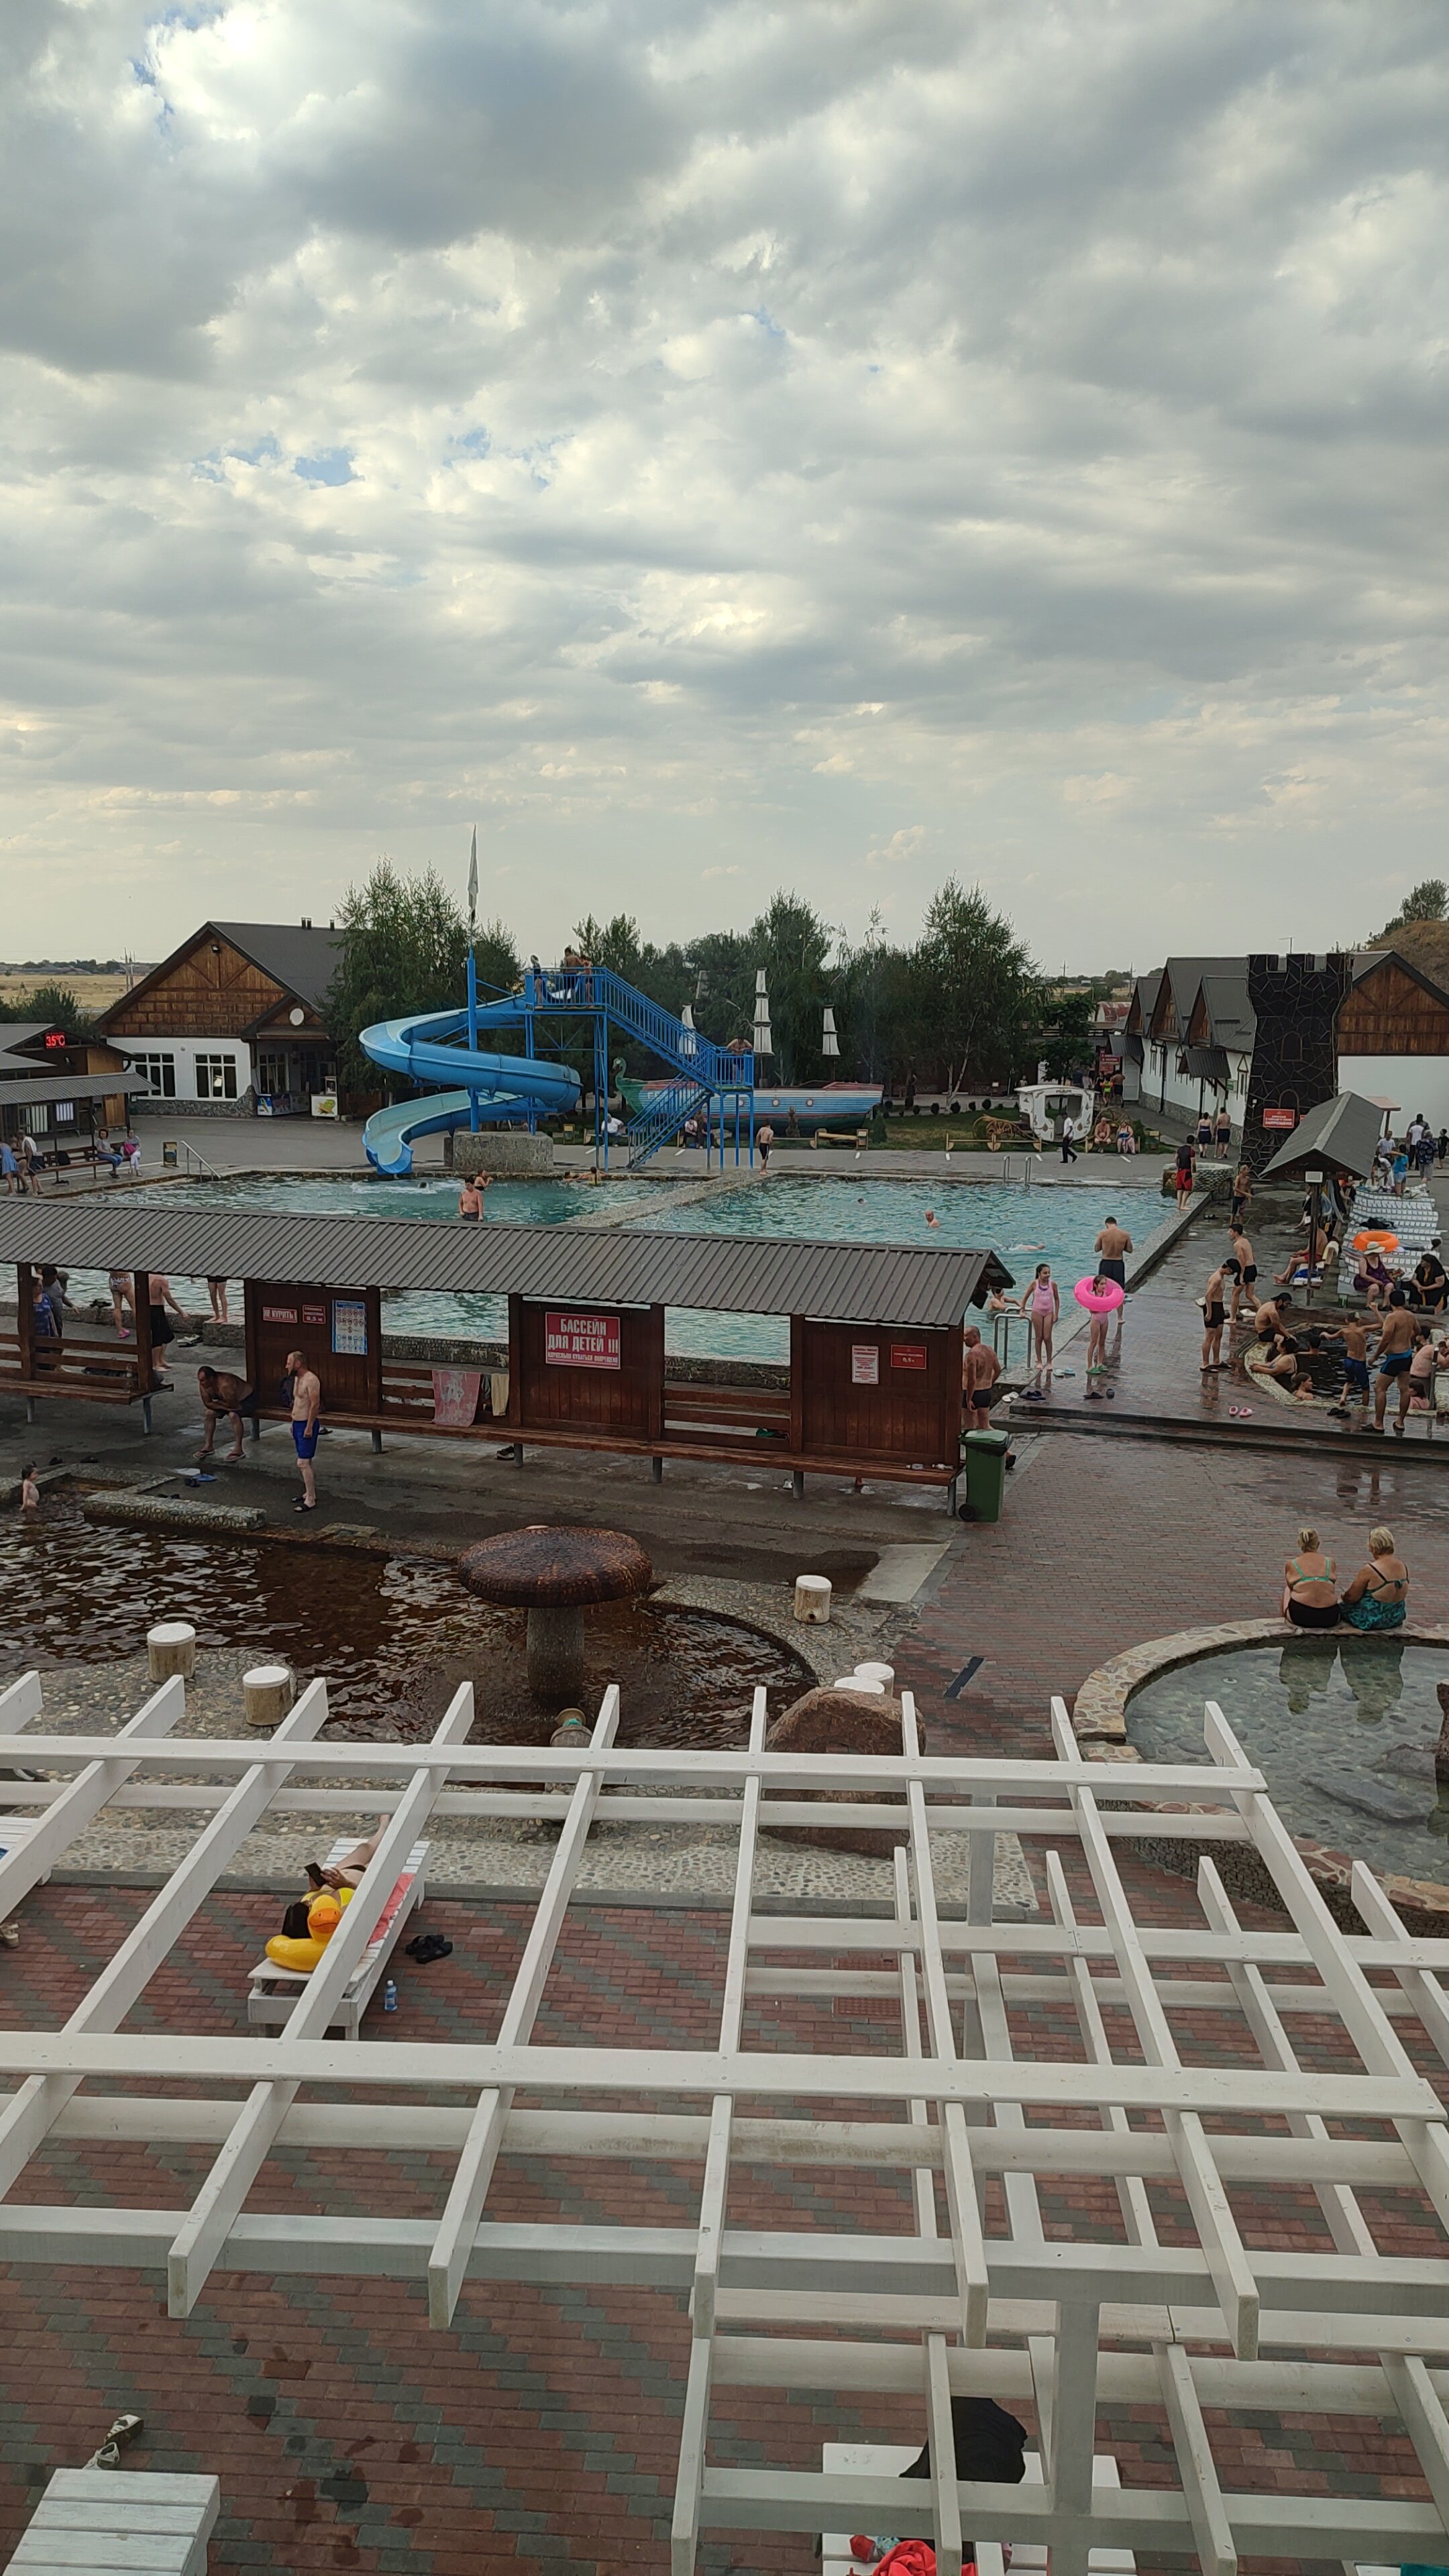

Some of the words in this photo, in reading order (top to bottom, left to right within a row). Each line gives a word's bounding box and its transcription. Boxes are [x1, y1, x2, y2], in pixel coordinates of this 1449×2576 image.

[272, 1310, 294, 1319] КУРИТЬ
[560, 1318, 606, 1336] БАССЕЙН
[548, 1334, 569, 1350] ДЛЯ
[572, 1336, 604, 1352] ДЕТЕЙ
